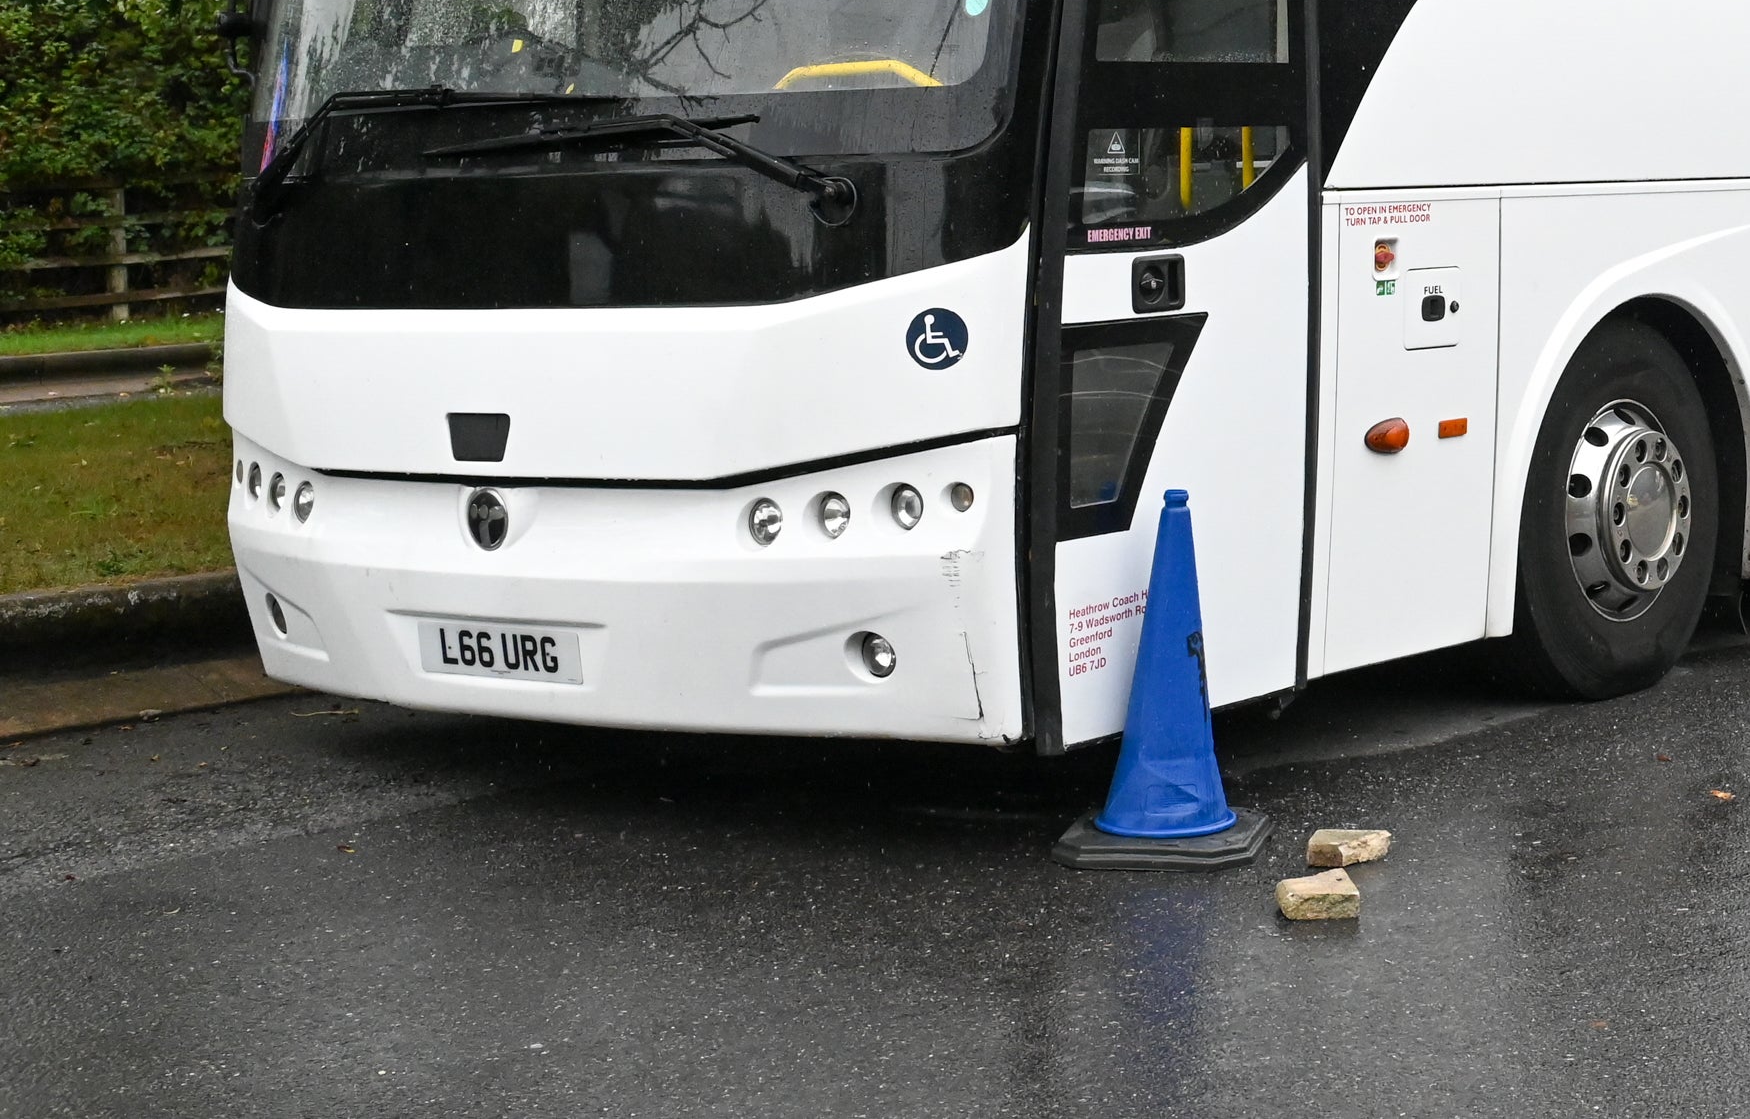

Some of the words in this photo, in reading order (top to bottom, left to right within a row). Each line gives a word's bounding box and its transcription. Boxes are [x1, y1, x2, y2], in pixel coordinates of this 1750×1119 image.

[1345, 207, 1355, 216] TO
[1357, 206, 1377, 215] OPEN
[1379, 205, 1387, 214] IN
[1388, 203, 1431, 213] EMERGENCY
[1345, 217, 1366, 226] TURN
[1368, 216, 1381, 225] TAP
[1383, 216, 1388, 224] &
[1390, 215, 1407, 224] PULL
[1410, 213, 1431, 222] DOOR
[1087, 228, 1134, 242] EMERGENCY
[1135, 226, 1152, 240] EXIT
[1423, 285, 1443, 295] FUEL
[1069, 601, 1110, 620] Heathrow
[1112, 592, 1139, 608] Coach
[1069, 621, 1084, 634] 7-9
[1085, 608, 1133, 629] Wadsworth
[1135, 605, 1147, 616] Ro
[1069, 627, 1113, 648] Greenford
[439, 627, 495, 668] L66
[500, 633, 559, 673] URG
[1069, 646, 1102, 663] London
[1068, 662, 1088, 677] UB6
[1090, 657, 1107, 671] 7JD
